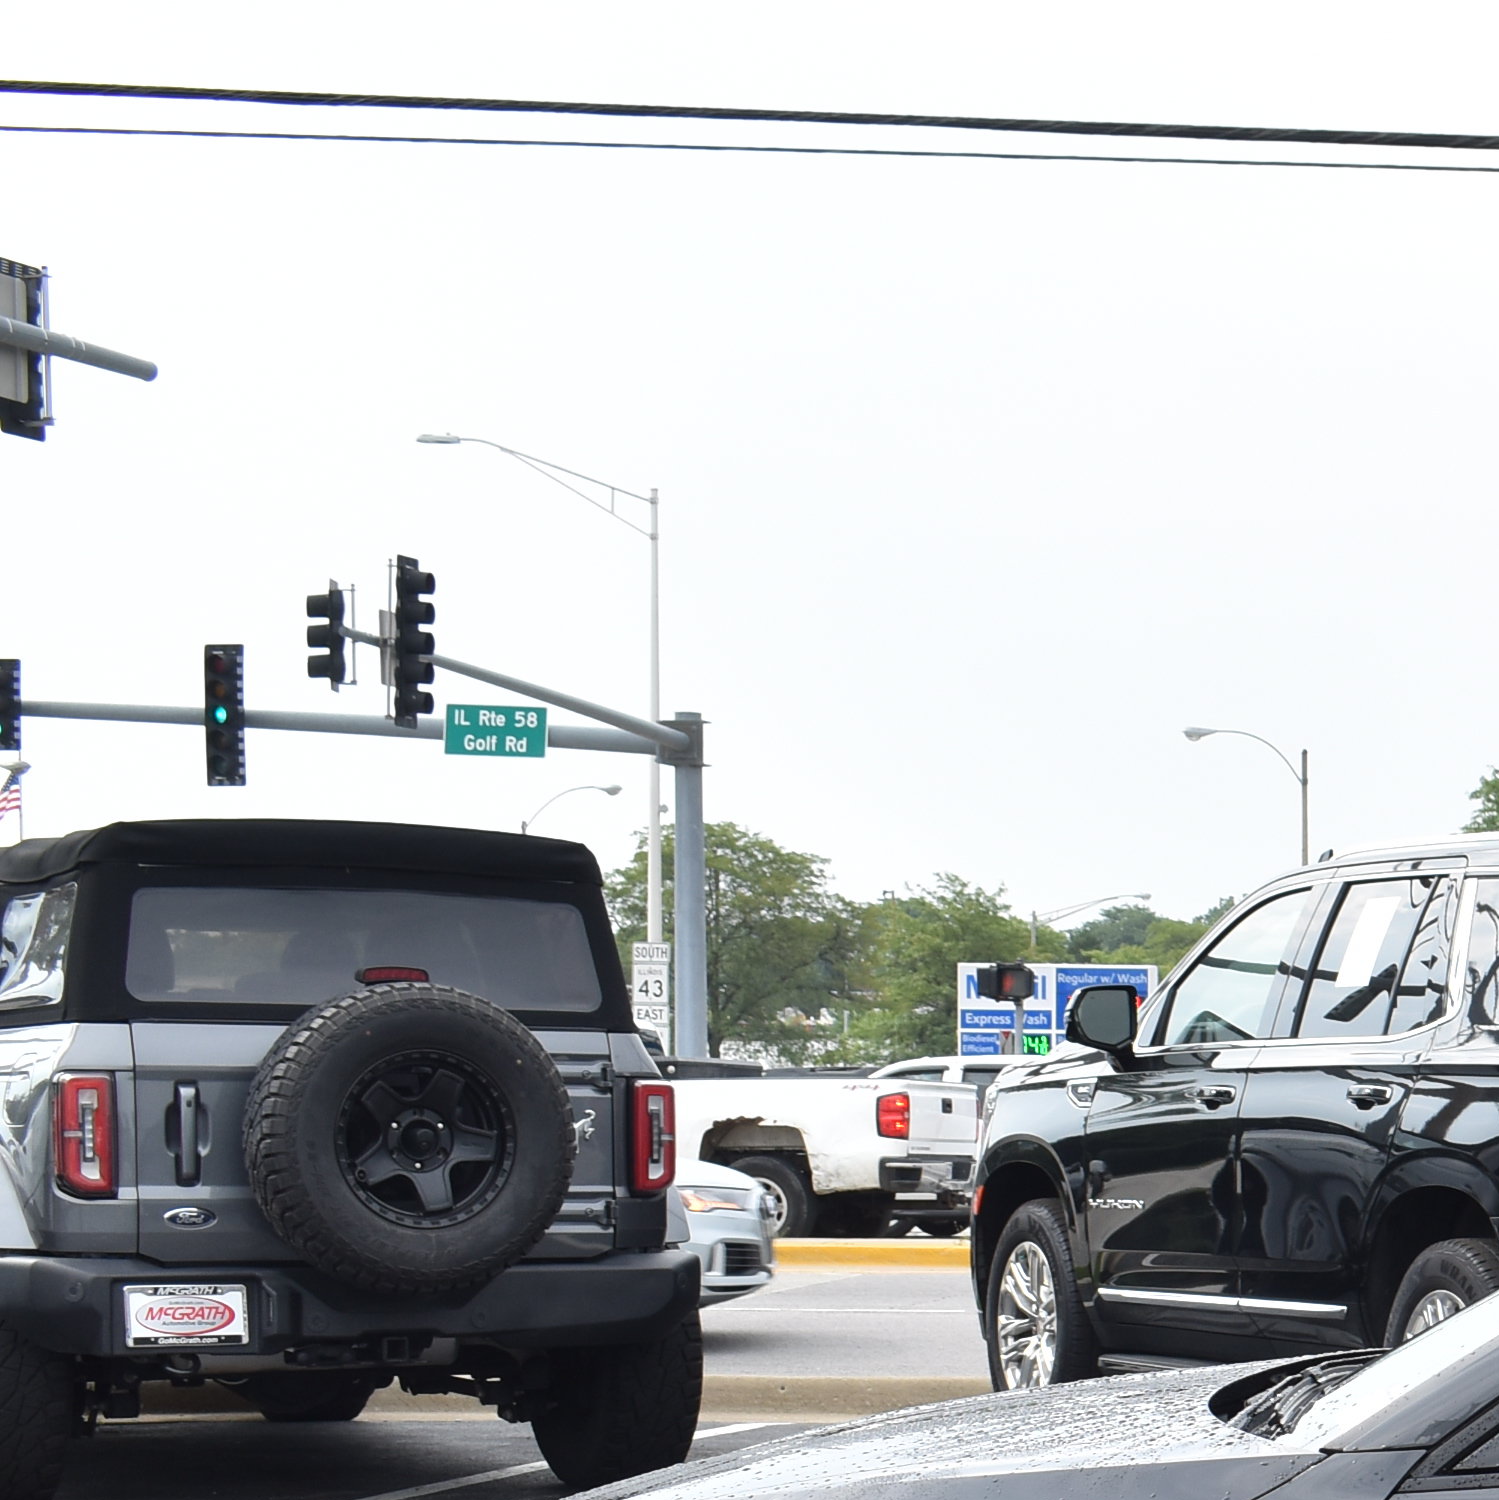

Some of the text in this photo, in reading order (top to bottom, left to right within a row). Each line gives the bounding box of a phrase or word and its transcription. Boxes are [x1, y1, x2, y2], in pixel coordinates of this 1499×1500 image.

[454, 709, 538, 728] IL Rte 58
[464, 734, 528, 753] Golf Rd
[634, 946, 668, 959] SOUTH
[1057, 973, 1148, 985] Regular w/ Wash
[638, 979, 664, 998] 43
[636, 1008, 665, 1020] EAST
[965, 1012, 1012, 1027] Express
[962, 1034, 997, 1042] Biodiesel
[962, 1044, 994, 1053] Efficient
[1088, 1198, 1145, 1209] YUKON
[176, 1212, 204, 1224] Ford
[145, 1306, 226, 1320] McGRATH
[158, 1336, 219, 1345] GoMcGrath.com
